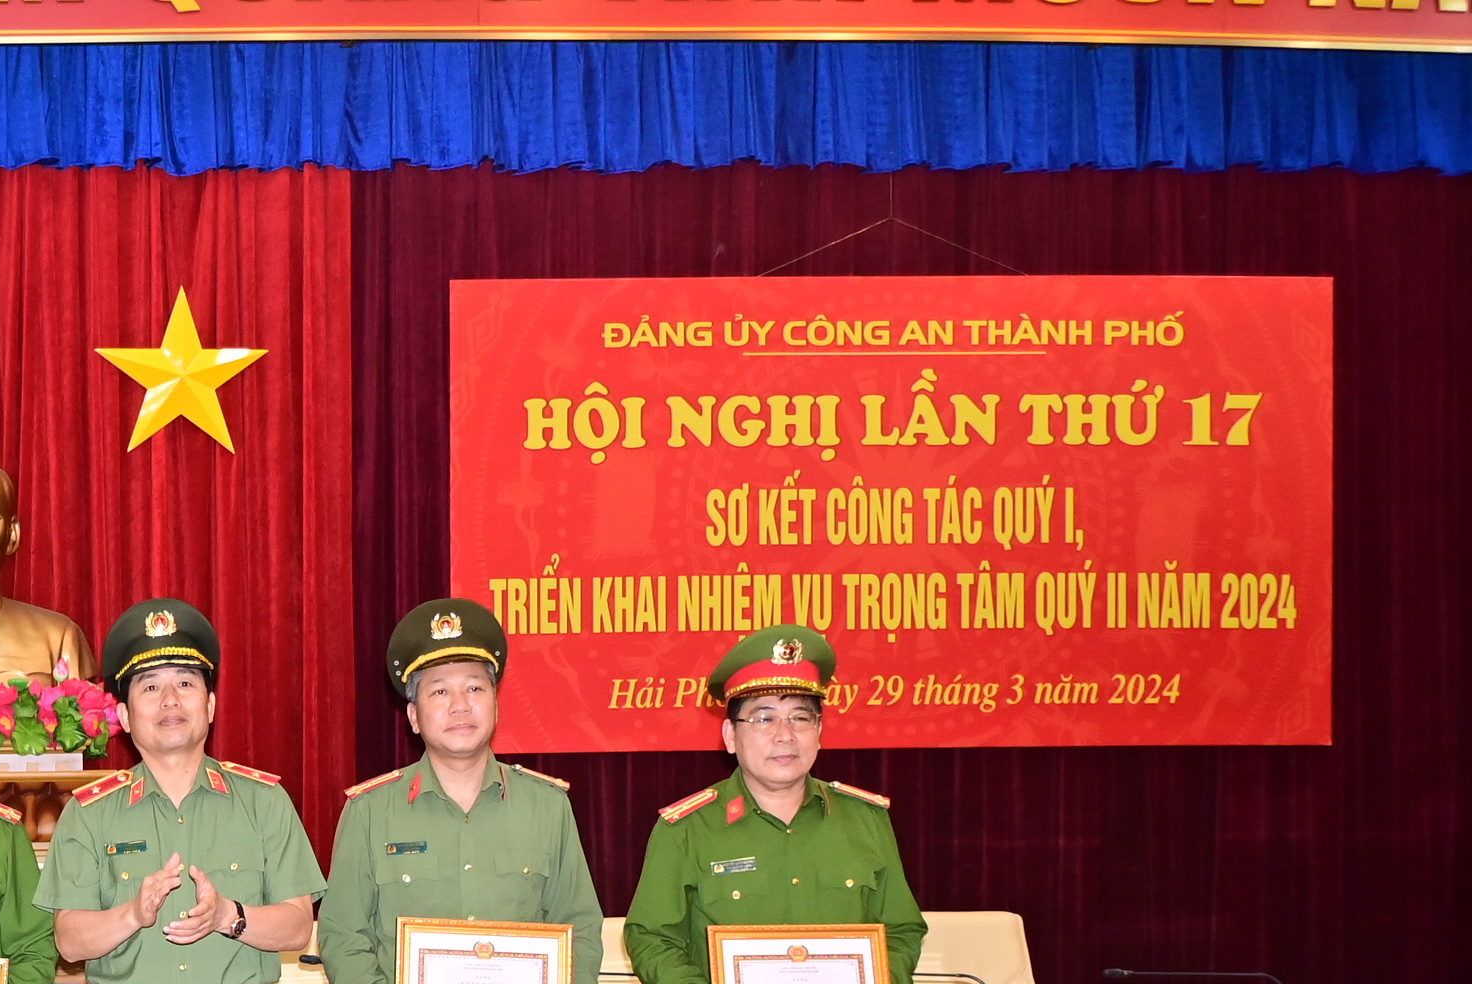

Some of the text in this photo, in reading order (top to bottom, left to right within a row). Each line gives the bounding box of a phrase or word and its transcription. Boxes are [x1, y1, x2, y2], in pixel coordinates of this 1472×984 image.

[601, 310, 1185, 348] ĐẢNG ỦY CÔNG AN THÀNH PHỐ
[523, 368, 1263, 464] HỘI NGHỊ LẦN THỨ 17
[705, 469, 1084, 551] SƠ KẾT CÔNG TÁC QUÝ I,
[489, 553, 582, 635] TRIỂN
[592, 575, 667, 634] KHAI
[677, 561, 782, 643] NHIỆM
[842, 572, 947, 643] TRỌNG
[956, 560, 1025, 629] TÂM
[1035, 559, 1097, 636] QUÝ
[1107, 572, 1127, 628] II
[1137, 560, 1211, 629] NĂM
[1221, 573, 1297, 630] 2024
[607, 676, 666, 709] Hải
[867, 675, 904, 706] 29
[913, 674, 1000, 713] tháng
[1006, 674, 1025, 705] 3
[1034, 675, 1099, 704] năm
[1108, 674, 1181, 704] 2024
